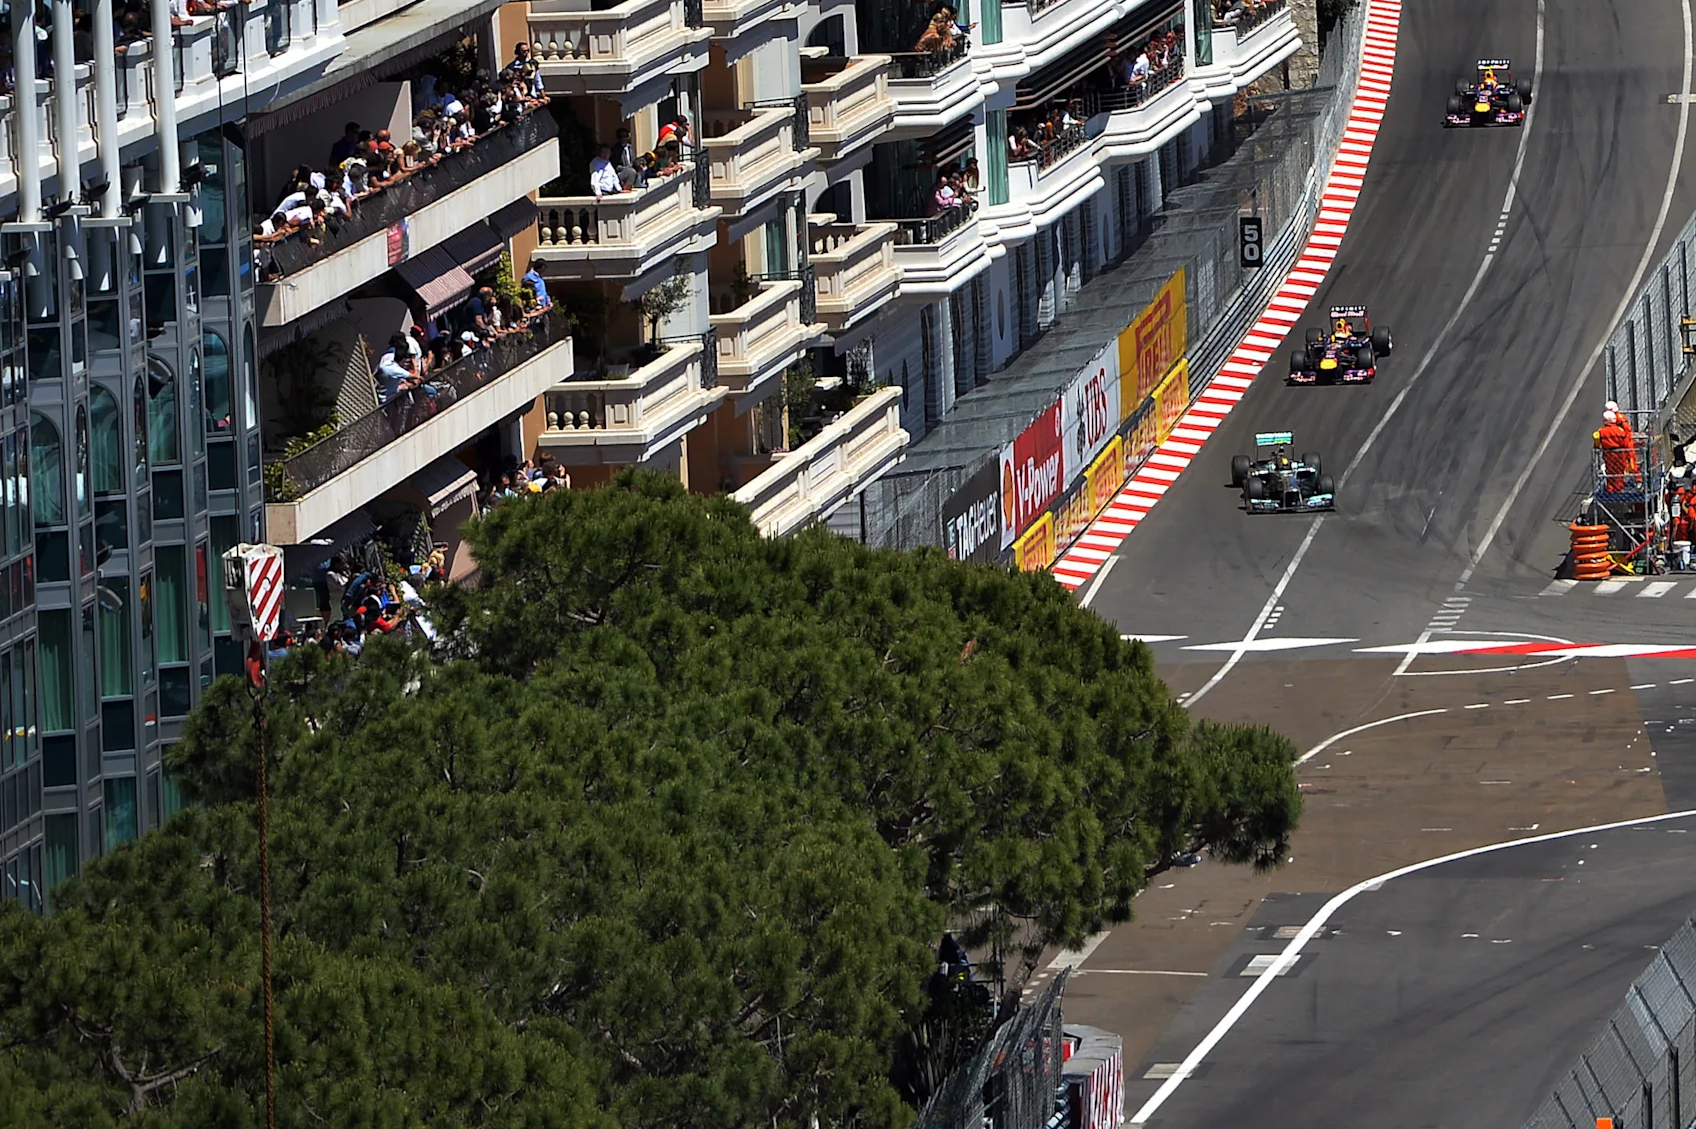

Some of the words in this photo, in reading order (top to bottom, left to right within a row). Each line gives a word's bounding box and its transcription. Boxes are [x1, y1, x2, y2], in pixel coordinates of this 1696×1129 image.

[1243, 224, 1260, 262] 50
[1084, 367, 1109, 449] UBS
[1016, 450, 1060, 524] V-Power
